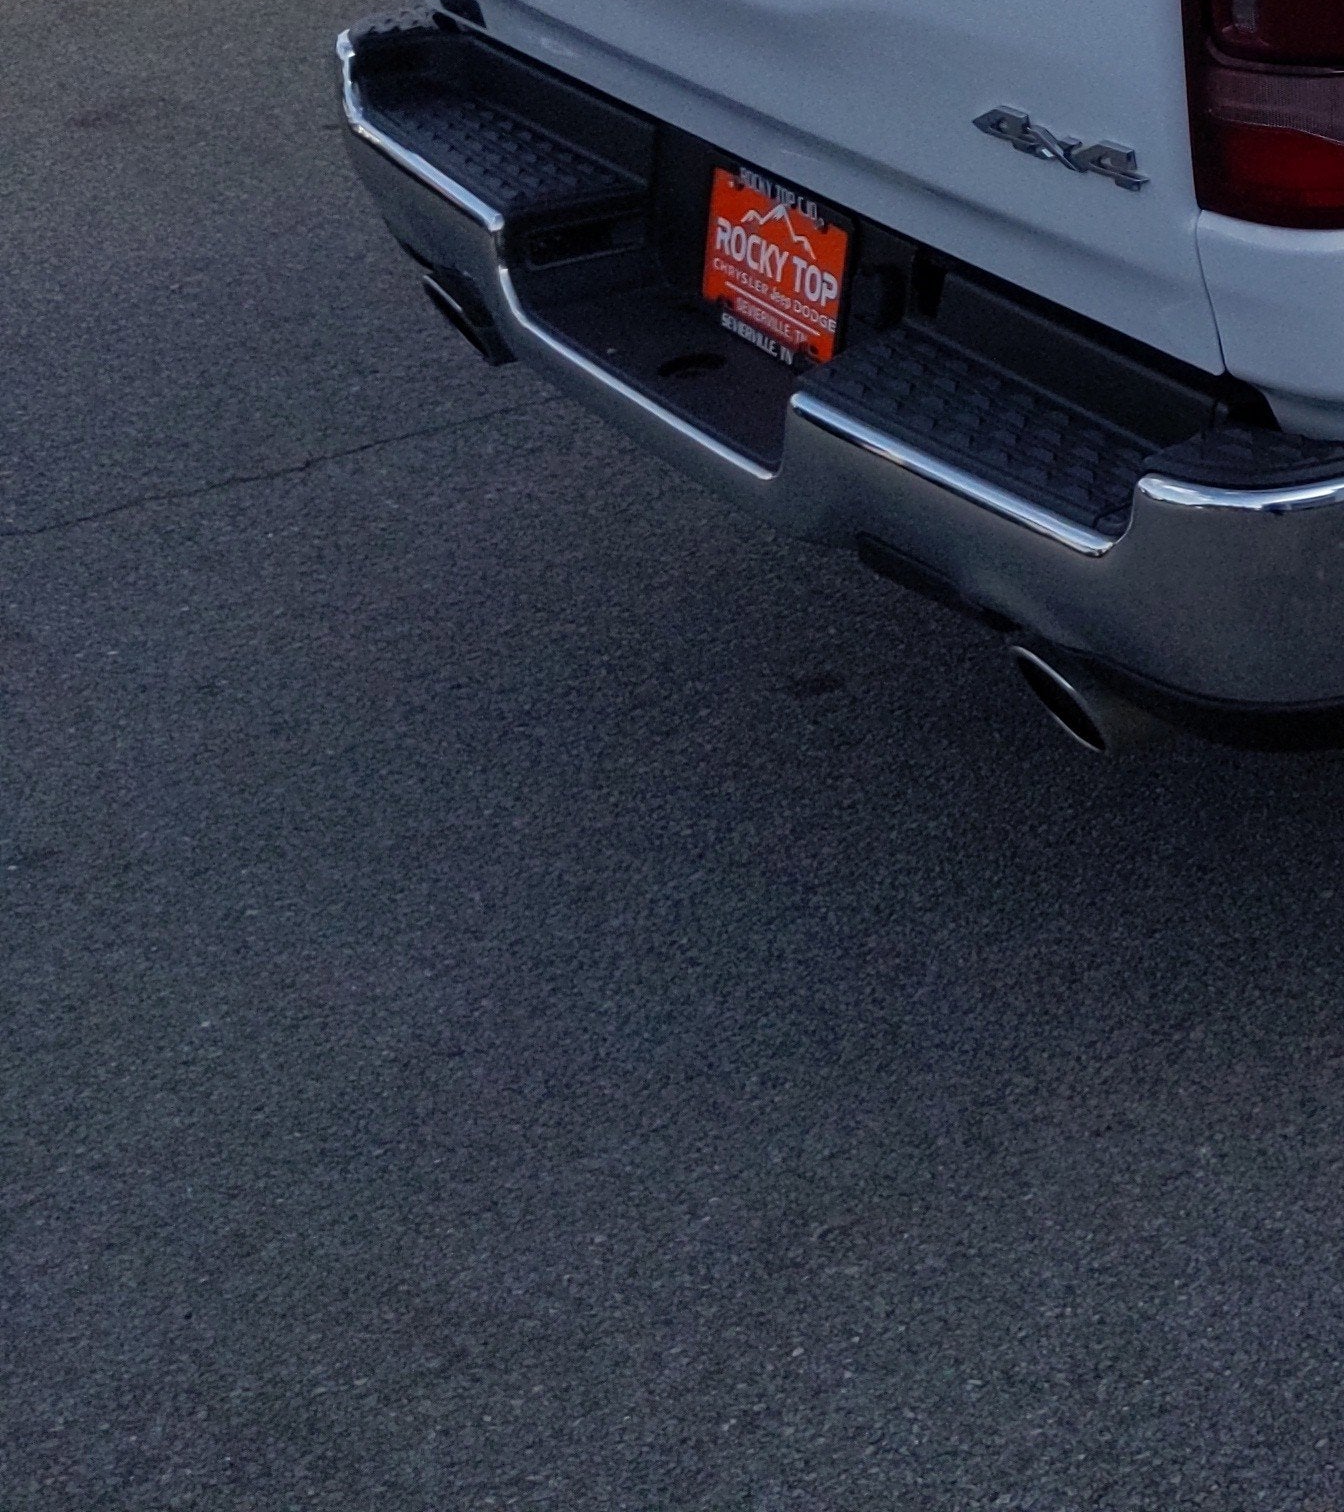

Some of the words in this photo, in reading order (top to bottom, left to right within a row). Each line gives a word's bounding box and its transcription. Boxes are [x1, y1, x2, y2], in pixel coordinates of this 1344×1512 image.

[714, 217, 789, 282] ROCKY
[792, 256, 838, 307] TOP
[794, 299, 837, 333] DODGE
